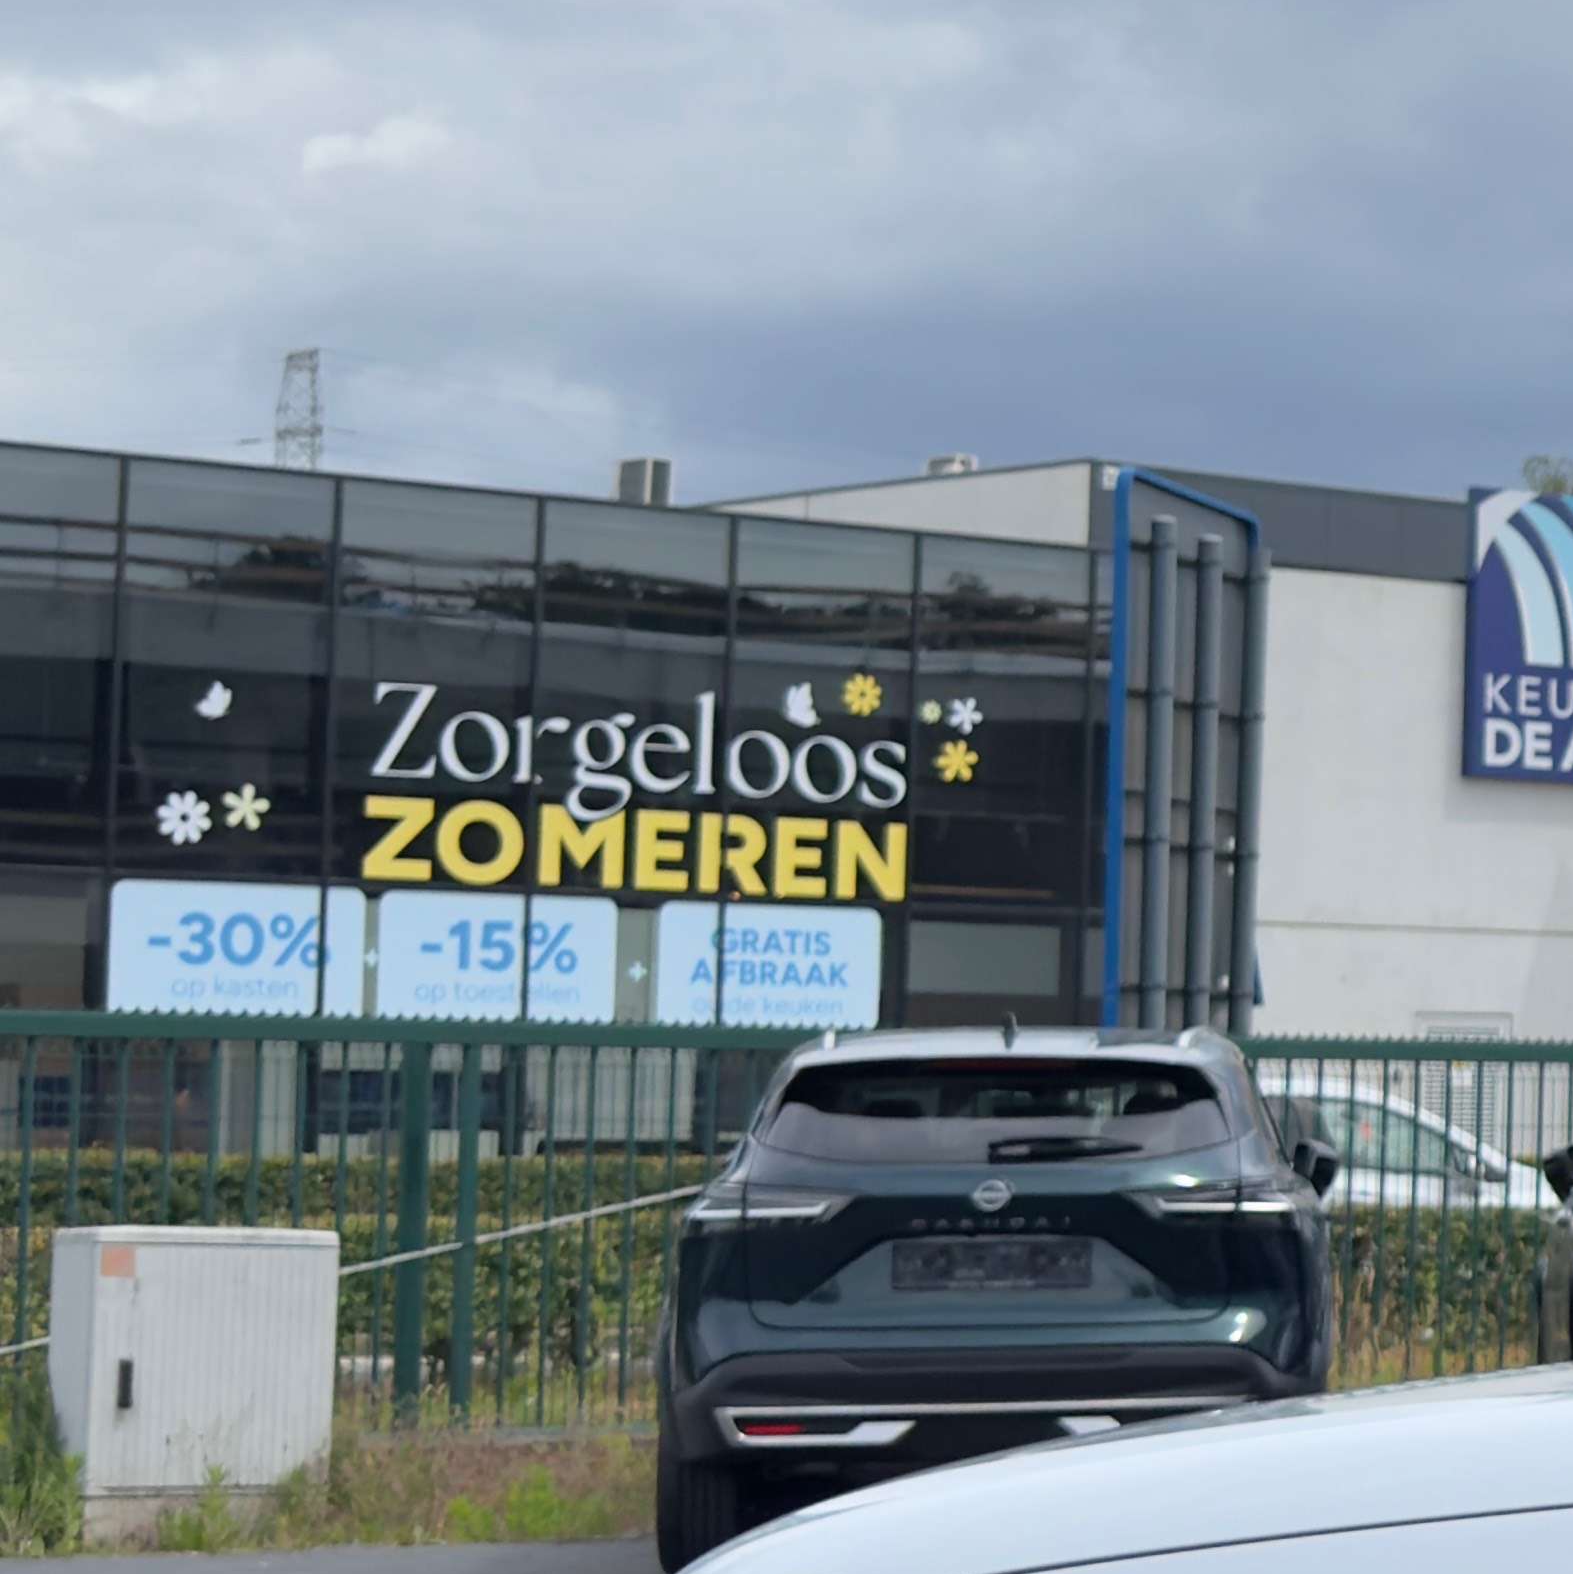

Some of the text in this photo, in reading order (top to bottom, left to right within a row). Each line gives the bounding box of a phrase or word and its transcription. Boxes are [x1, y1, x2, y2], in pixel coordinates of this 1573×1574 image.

[370, 681, 908, 822] Zorgeloos
[1483, 718, 1554, 770] DE
[361, 795, 908, 902] ZOMEREN
[146, 911, 332, 968] -30%
[419, 919, 578, 975] -15%
[711, 927, 833, 957] GRATIS
[170, 974, 300, 1001] op kasten
[690, 958, 849, 988] AFBRAAK
[414, 983, 447, 1005] op
[691, 994, 843, 1017] ode keuken
